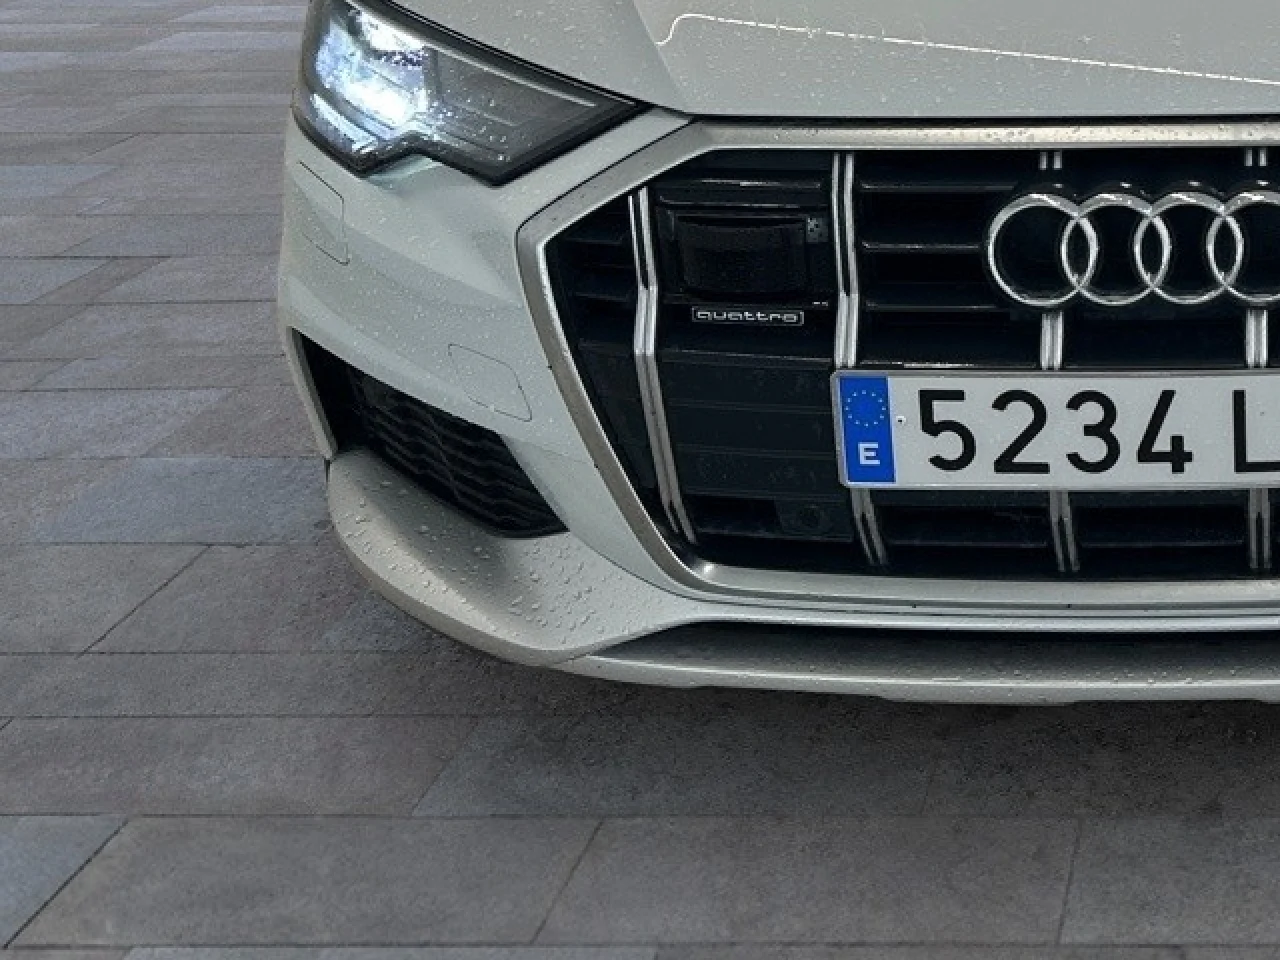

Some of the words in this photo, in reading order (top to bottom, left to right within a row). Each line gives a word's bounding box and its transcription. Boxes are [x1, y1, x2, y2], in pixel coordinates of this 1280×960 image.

[696, 311, 799, 323] quattro
[918, 389, 1193, 475] 5234
[858, 443, 881, 466] E
